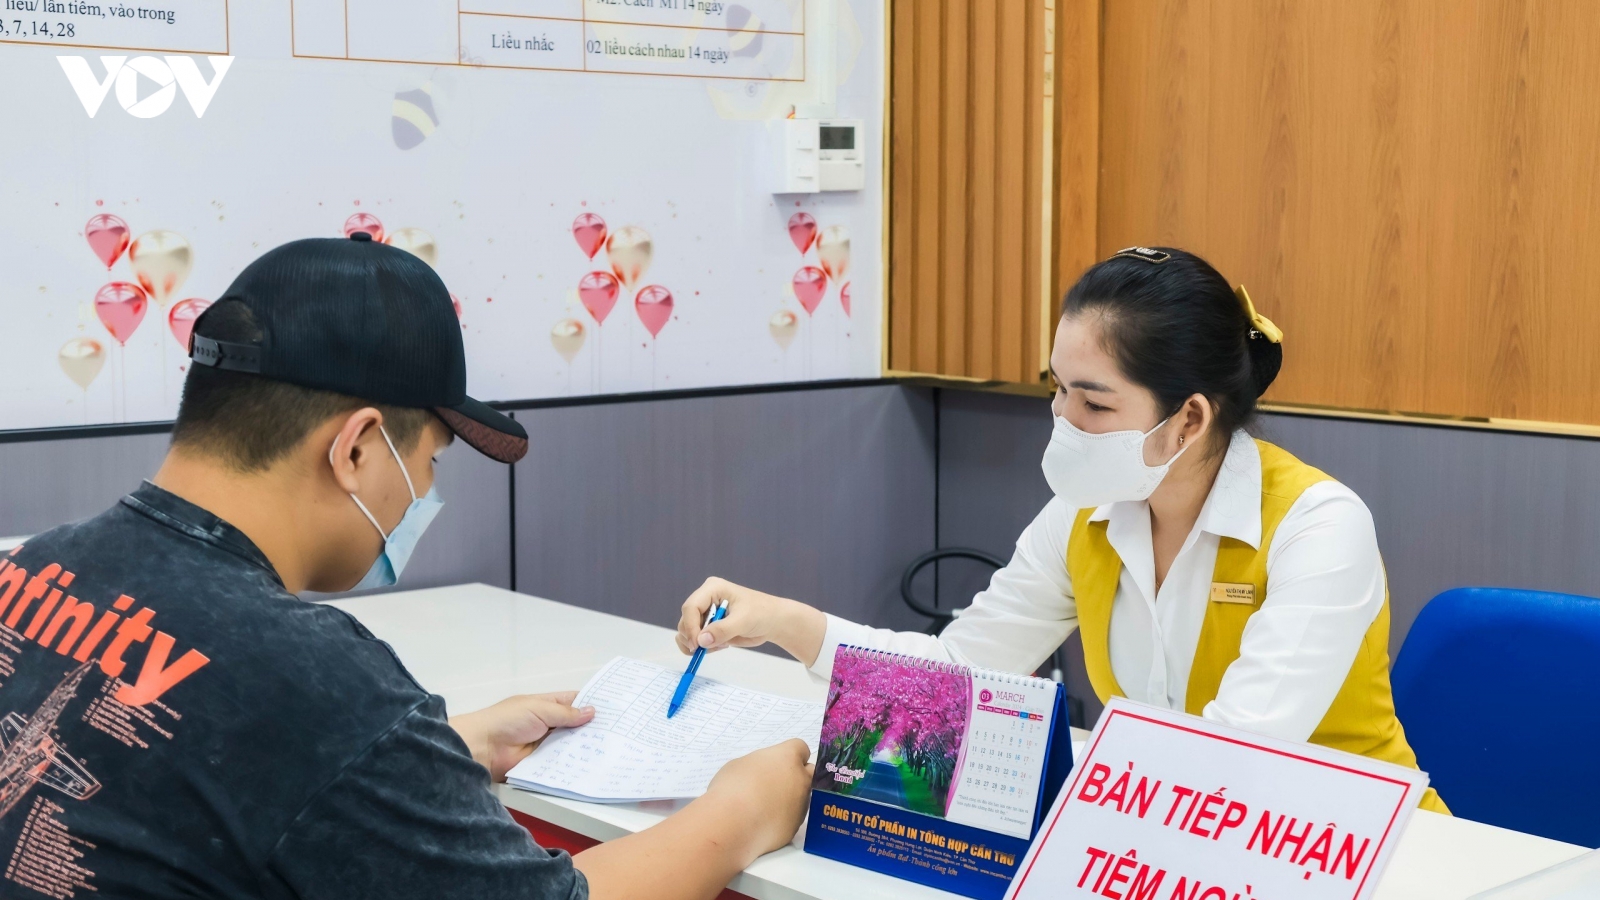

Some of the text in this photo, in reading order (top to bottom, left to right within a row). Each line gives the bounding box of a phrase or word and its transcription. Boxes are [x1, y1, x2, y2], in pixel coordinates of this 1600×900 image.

[68, 0, 106, 19] tiêm,
[110, 3, 135, 18] vào
[138, 6, 175, 24] trong
[13, 20, 26, 37] 7,
[32, 21, 54, 39] 14,
[56, 22, 75, 38] 28
[492, 31, 554, 51] Liều nhắc
[586, 38, 729, 63] 02 liều cách nhau 14 ngày
[995, 690, 1026, 703] MARCH
[823, 804, 849, 821] CÔNG
[851, 812, 863, 824] TY
[864, 815, 880, 829] CỔ
[907, 827, 918, 840] IN
[920, 830, 946, 848] TỔNG
[1077, 761, 1370, 880] BÀN TIẾP NHẬN
[1077, 847, 1167, 900] TIÊM
